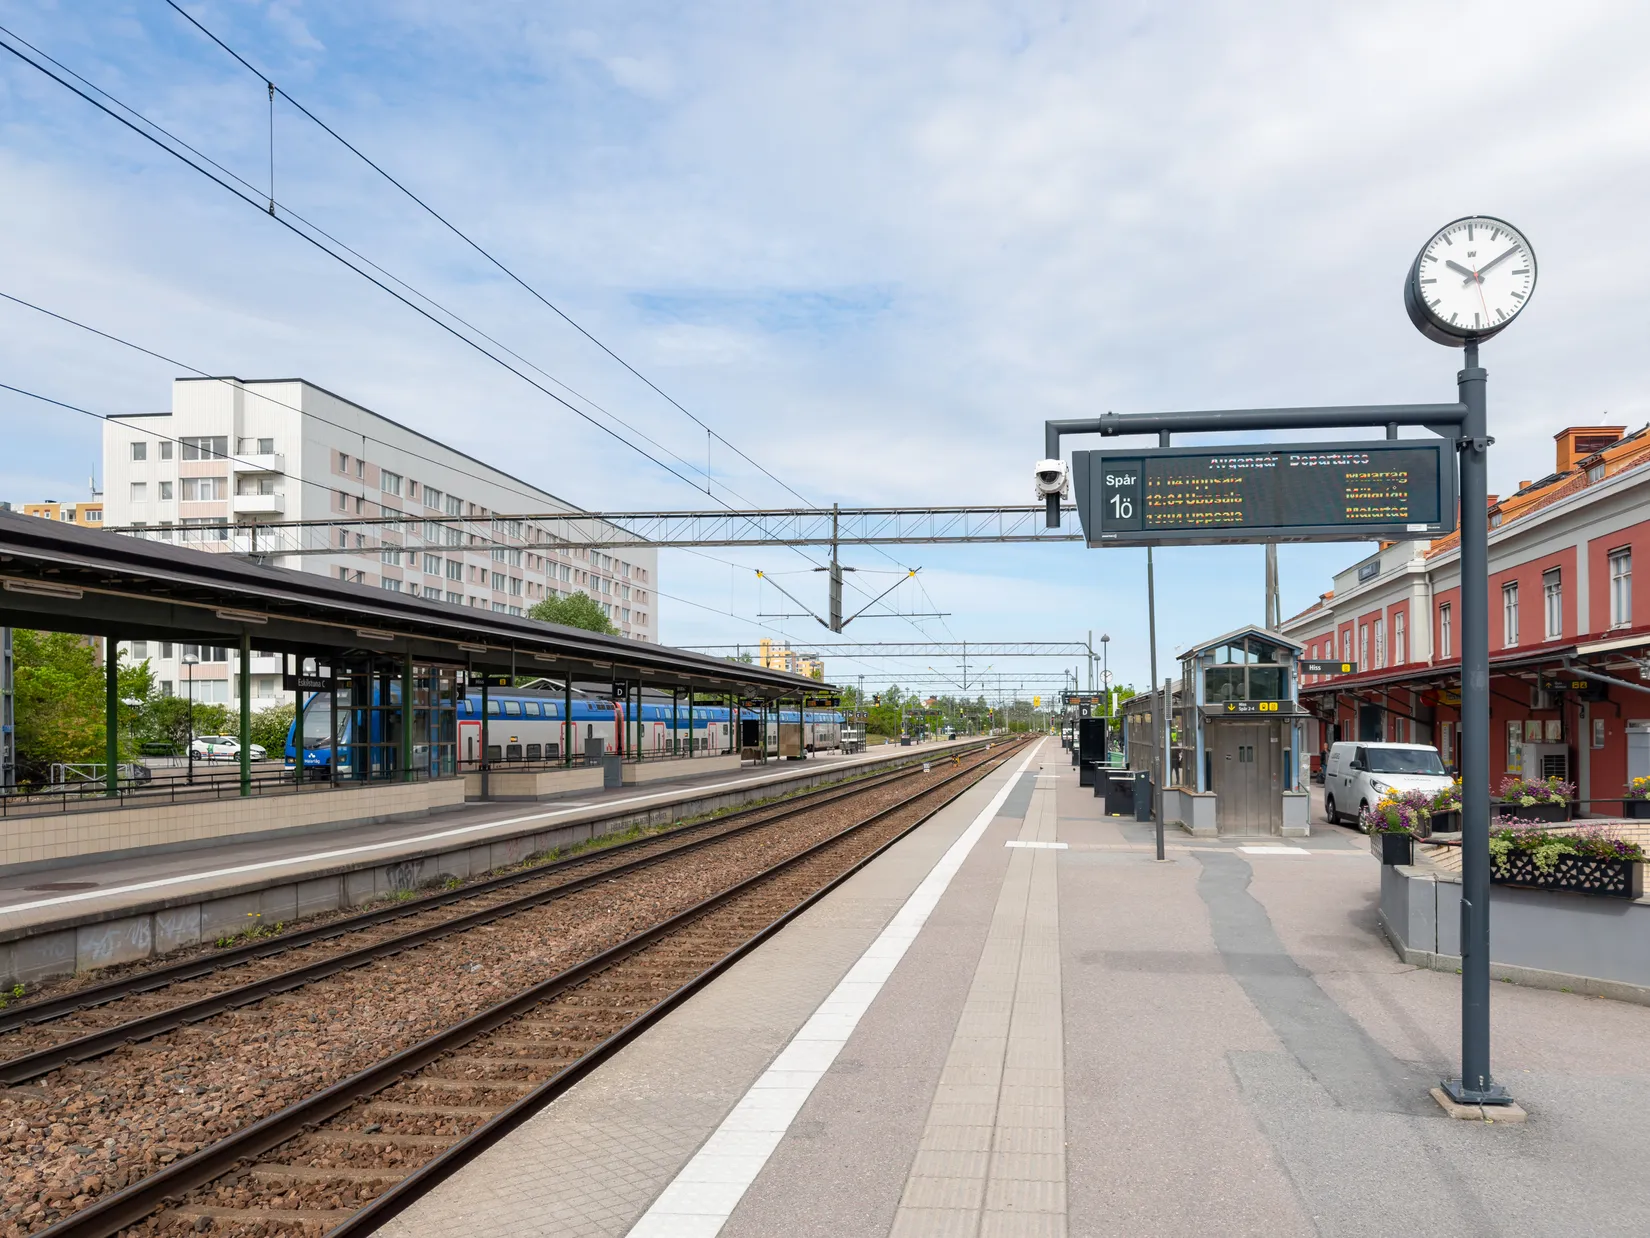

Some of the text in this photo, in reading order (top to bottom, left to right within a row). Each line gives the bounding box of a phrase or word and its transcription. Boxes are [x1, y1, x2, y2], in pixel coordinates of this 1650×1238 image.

[1106, 474, 1137, 488] Spår
[1110, 493, 1133, 519] 1ö
[297, 679, 326, 688] Eskilstuna C
[617, 688, 623, 696] D
[1082, 708, 1088, 716] D
